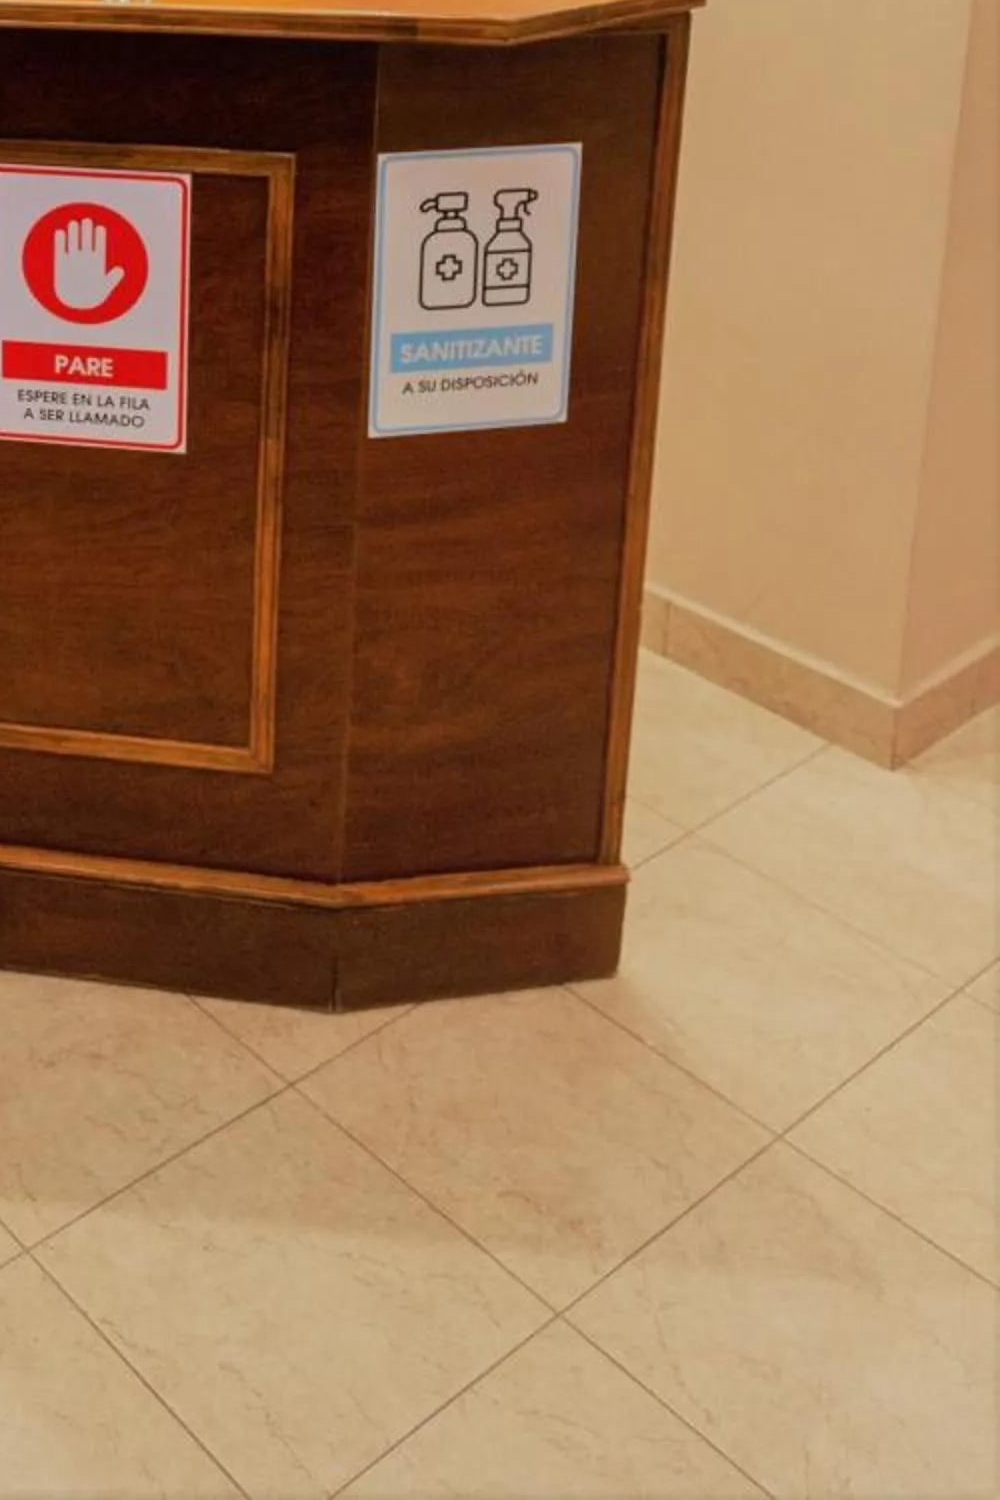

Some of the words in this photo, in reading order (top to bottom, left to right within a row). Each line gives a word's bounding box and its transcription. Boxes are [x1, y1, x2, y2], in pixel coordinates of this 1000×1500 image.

[401, 335, 543, 363] SANITIZANTE
[54, 355, 113, 378] PARE
[402, 382, 414, 395] A
[418, 379, 436, 393] SU
[441, 369, 539, 392] DISPOSICIÓN
[17, 389, 67, 405] ESPERE
[72, 392, 92, 406] EN
[97, 394, 116, 408] LA
[119, 396, 151, 411] FILA
[23, 407, 34, 420] A
[39, 408, 64, 422] SER
[69, 410, 145, 428] LLAMADO
